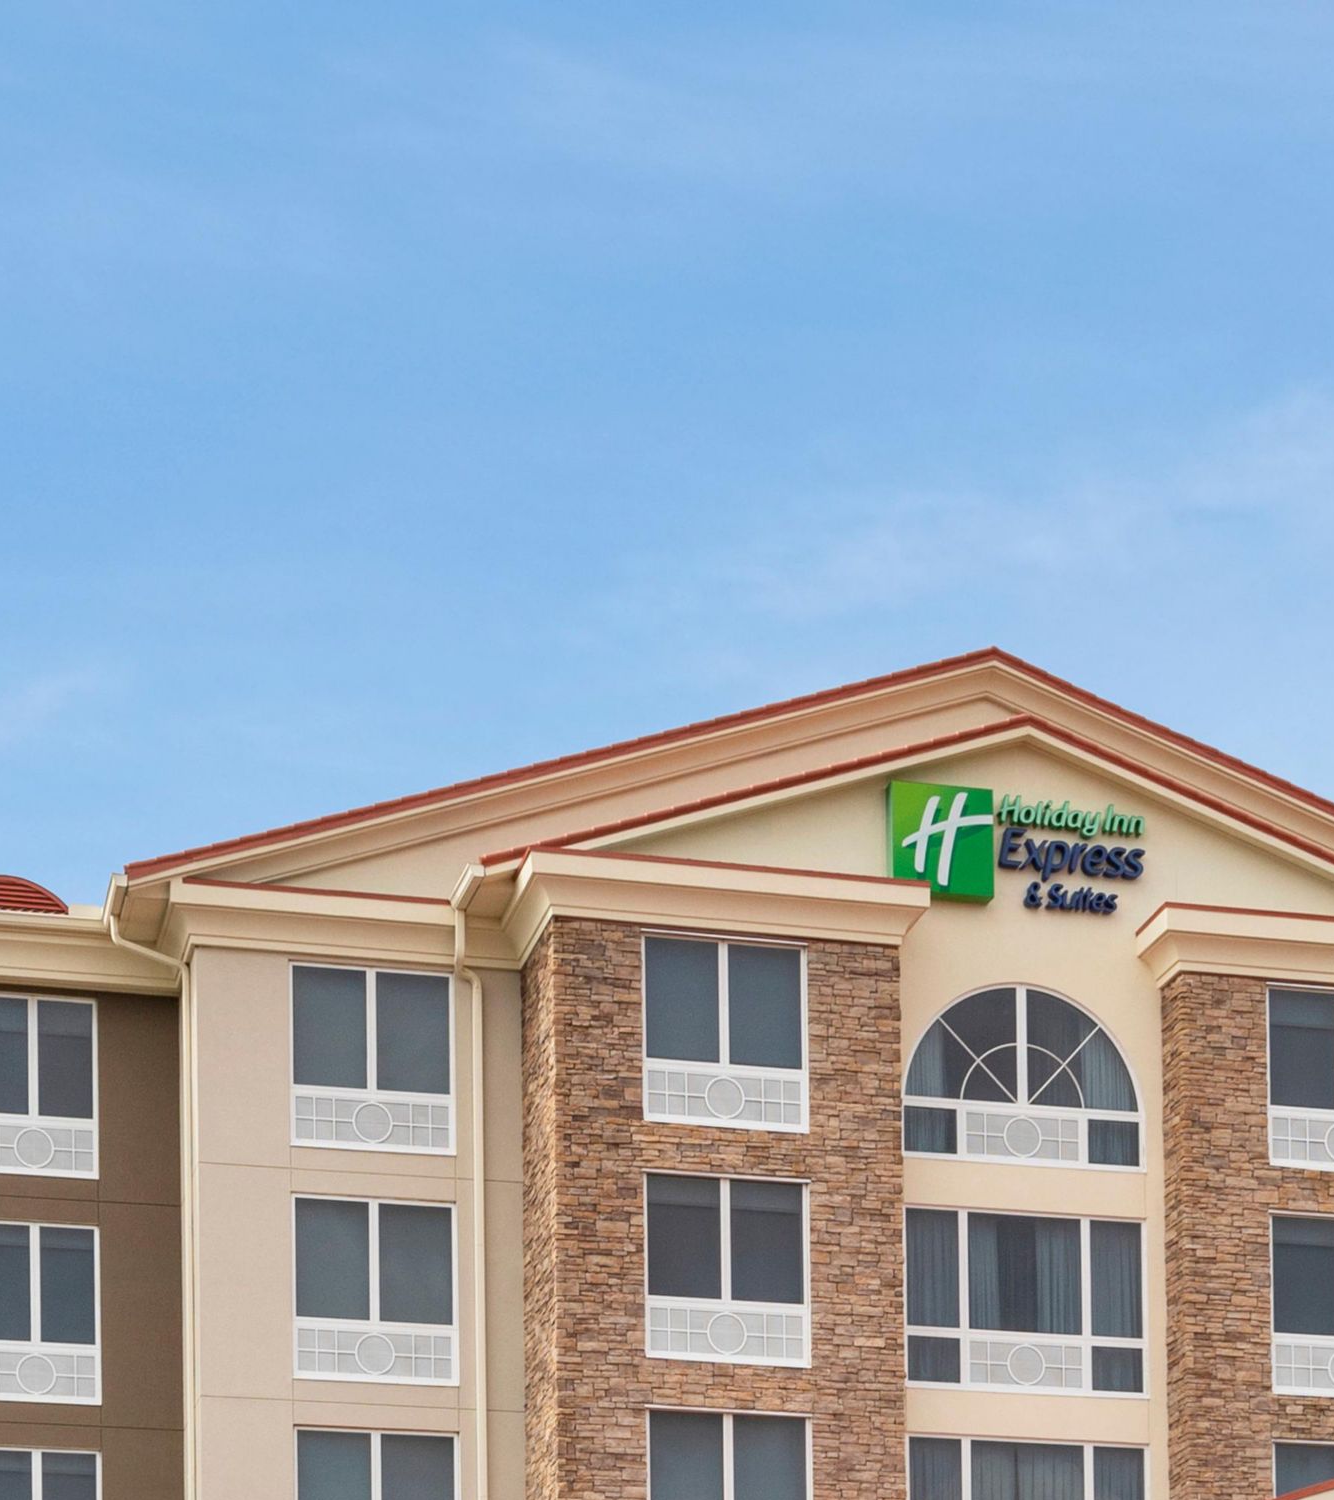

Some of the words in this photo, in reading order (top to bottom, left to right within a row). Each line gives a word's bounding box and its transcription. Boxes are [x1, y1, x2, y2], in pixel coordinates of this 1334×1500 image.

[901, 791, 994, 887] H
[997, 794, 1101, 838] Holiday
[1102, 804, 1146, 838] Inn
[998, 827, 1146, 883] Express
[1023, 881, 1043, 909] &
[1045, 883, 1119, 914] Suites
